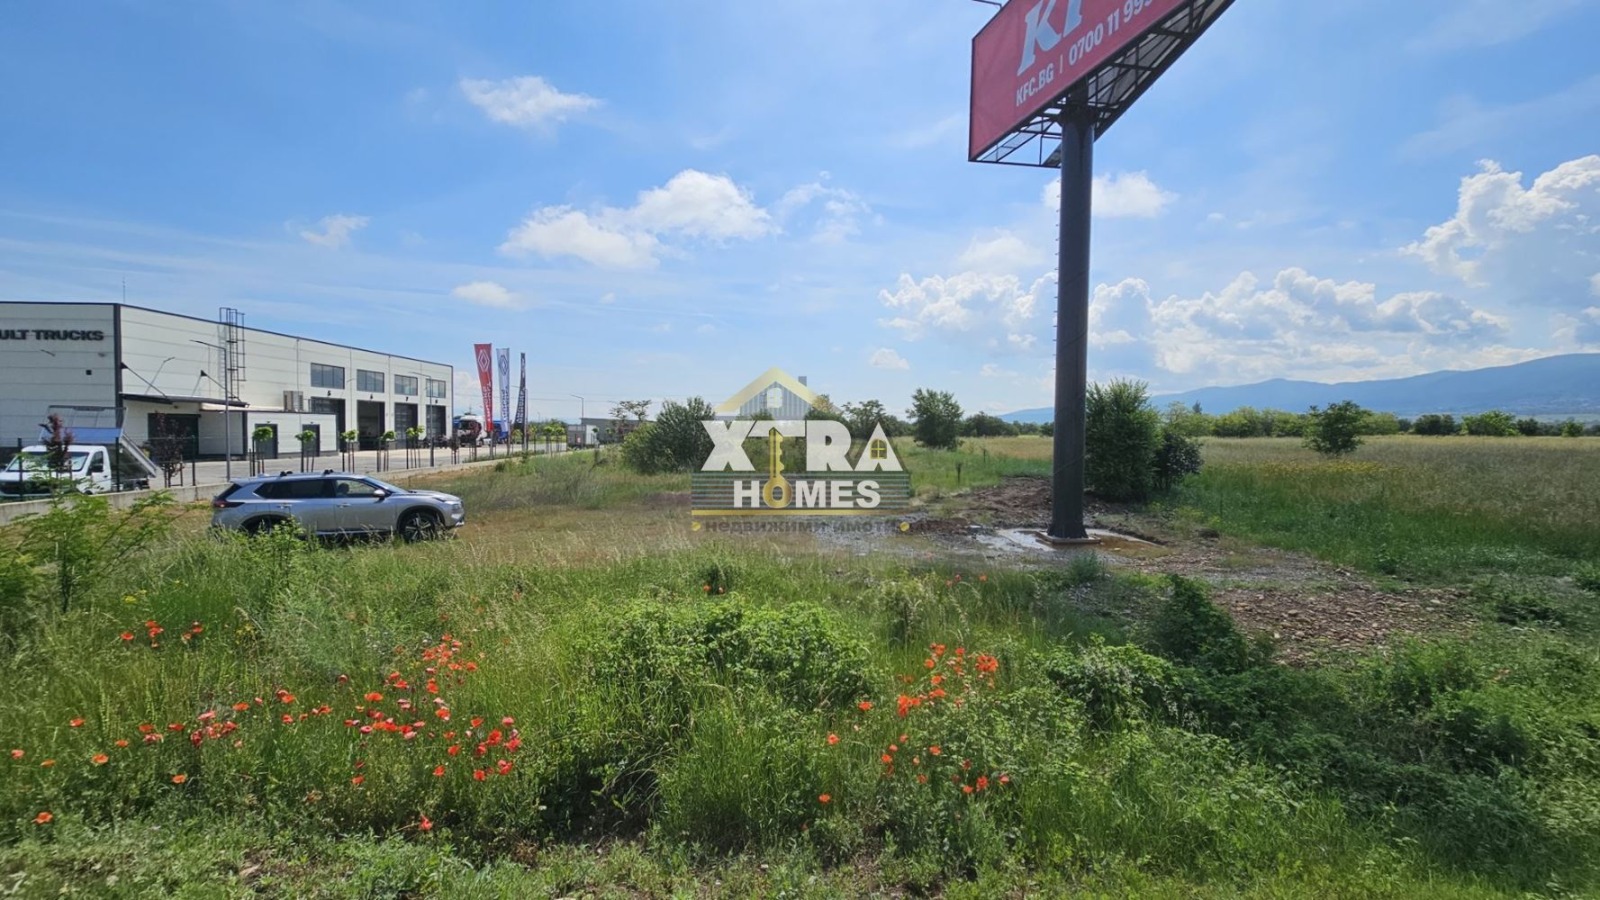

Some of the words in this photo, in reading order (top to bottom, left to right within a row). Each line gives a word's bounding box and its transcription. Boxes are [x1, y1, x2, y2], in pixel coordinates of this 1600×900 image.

[1016, 63, 1054, 107] KFC.BG
[1068, 22, 1104, 66] 0700
[1107, 8, 1120, 36] 11
[31, 329, 104, 341] TRUCKS
